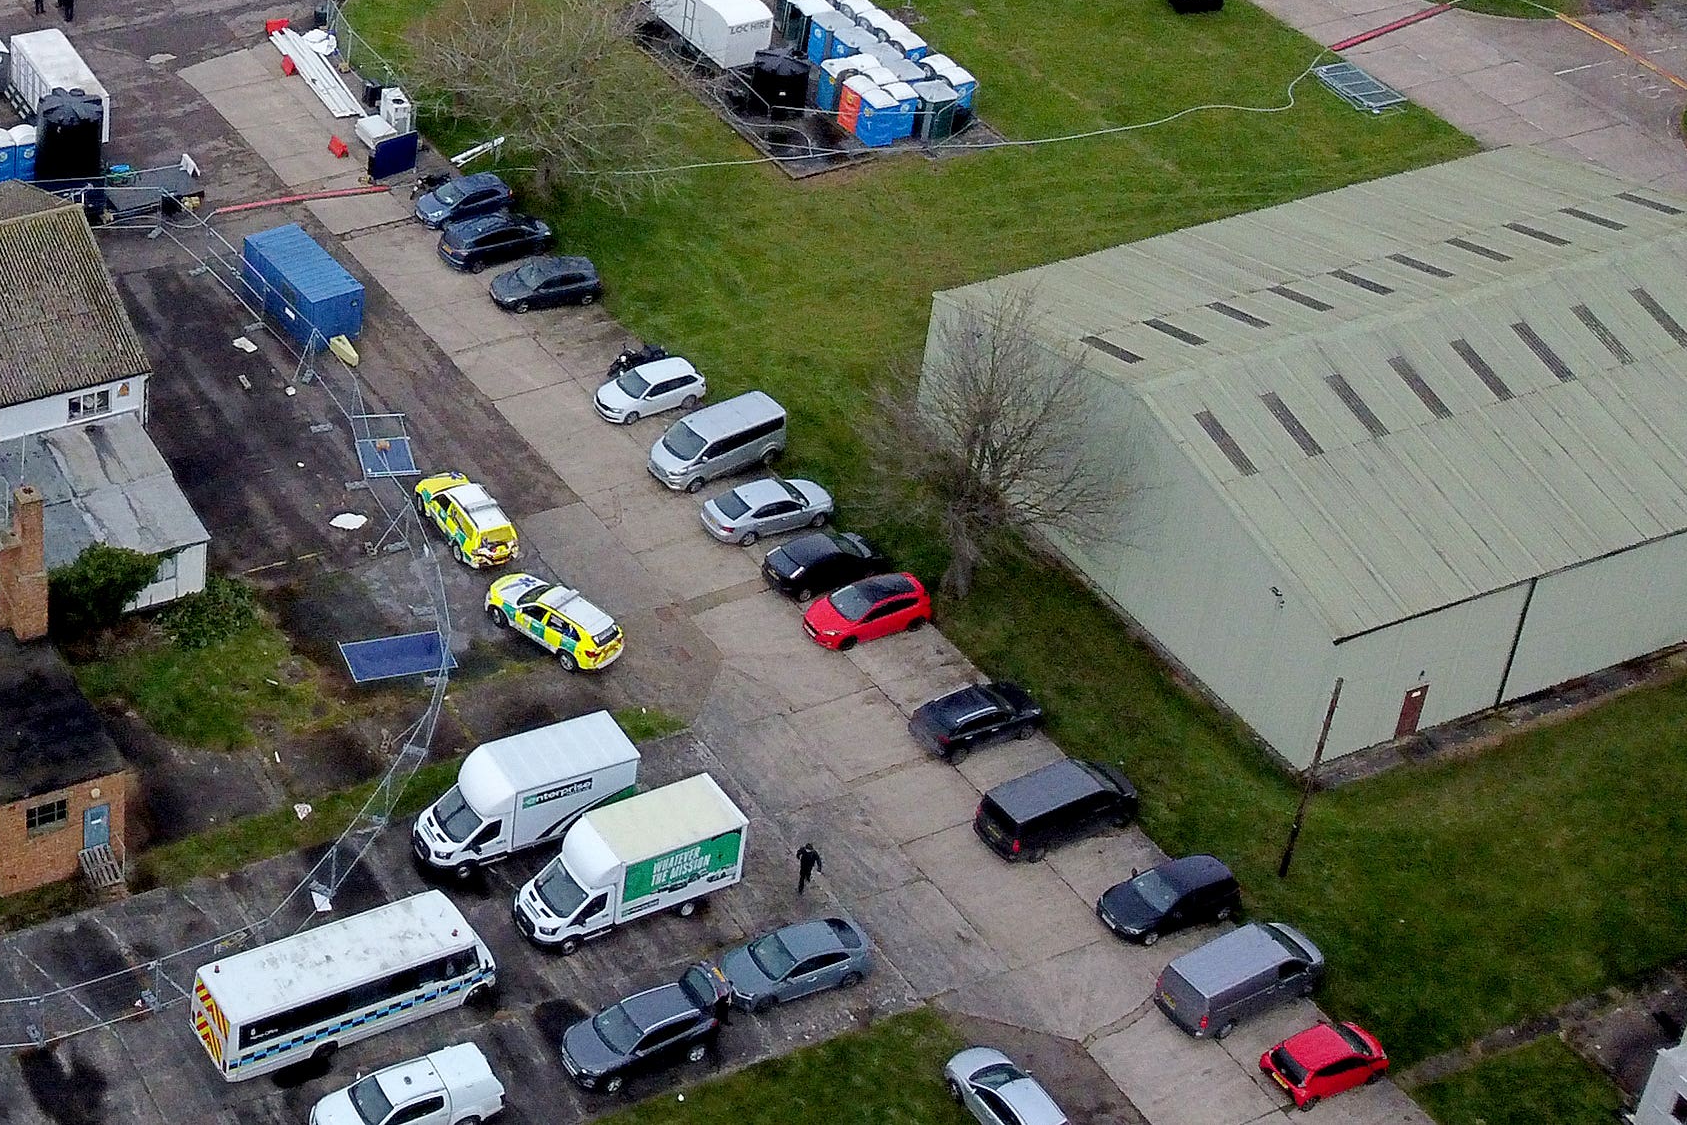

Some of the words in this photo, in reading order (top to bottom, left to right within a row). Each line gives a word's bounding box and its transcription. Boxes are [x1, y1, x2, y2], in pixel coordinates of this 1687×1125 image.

[651, 871, 669, 887] THE
[669, 853, 712, 880] MISSION
[653, 846, 701, 874] WHATEVER
